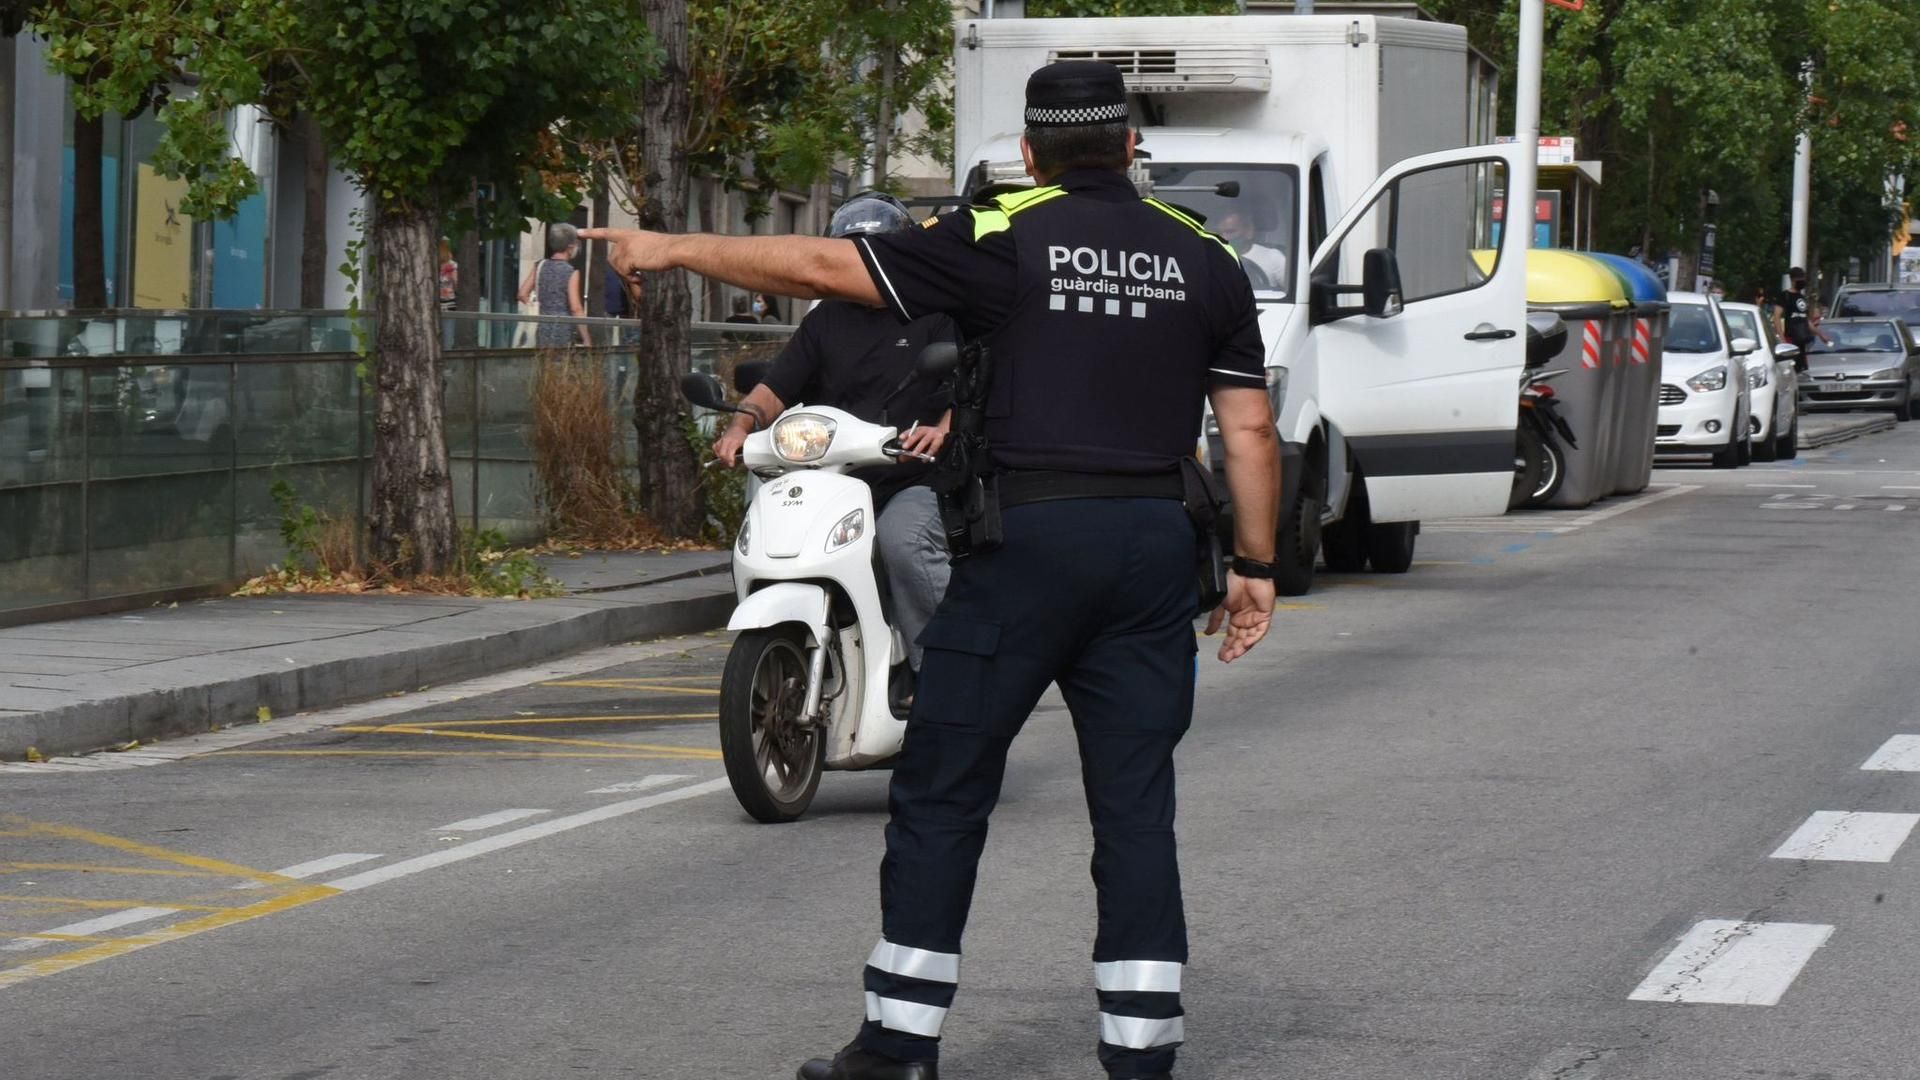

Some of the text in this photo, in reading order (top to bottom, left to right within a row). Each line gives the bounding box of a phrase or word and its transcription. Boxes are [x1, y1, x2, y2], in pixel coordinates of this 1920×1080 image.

[1049, 246, 1185, 284] POLICIA
[1051, 277, 1185, 301] guàrdia urbana
